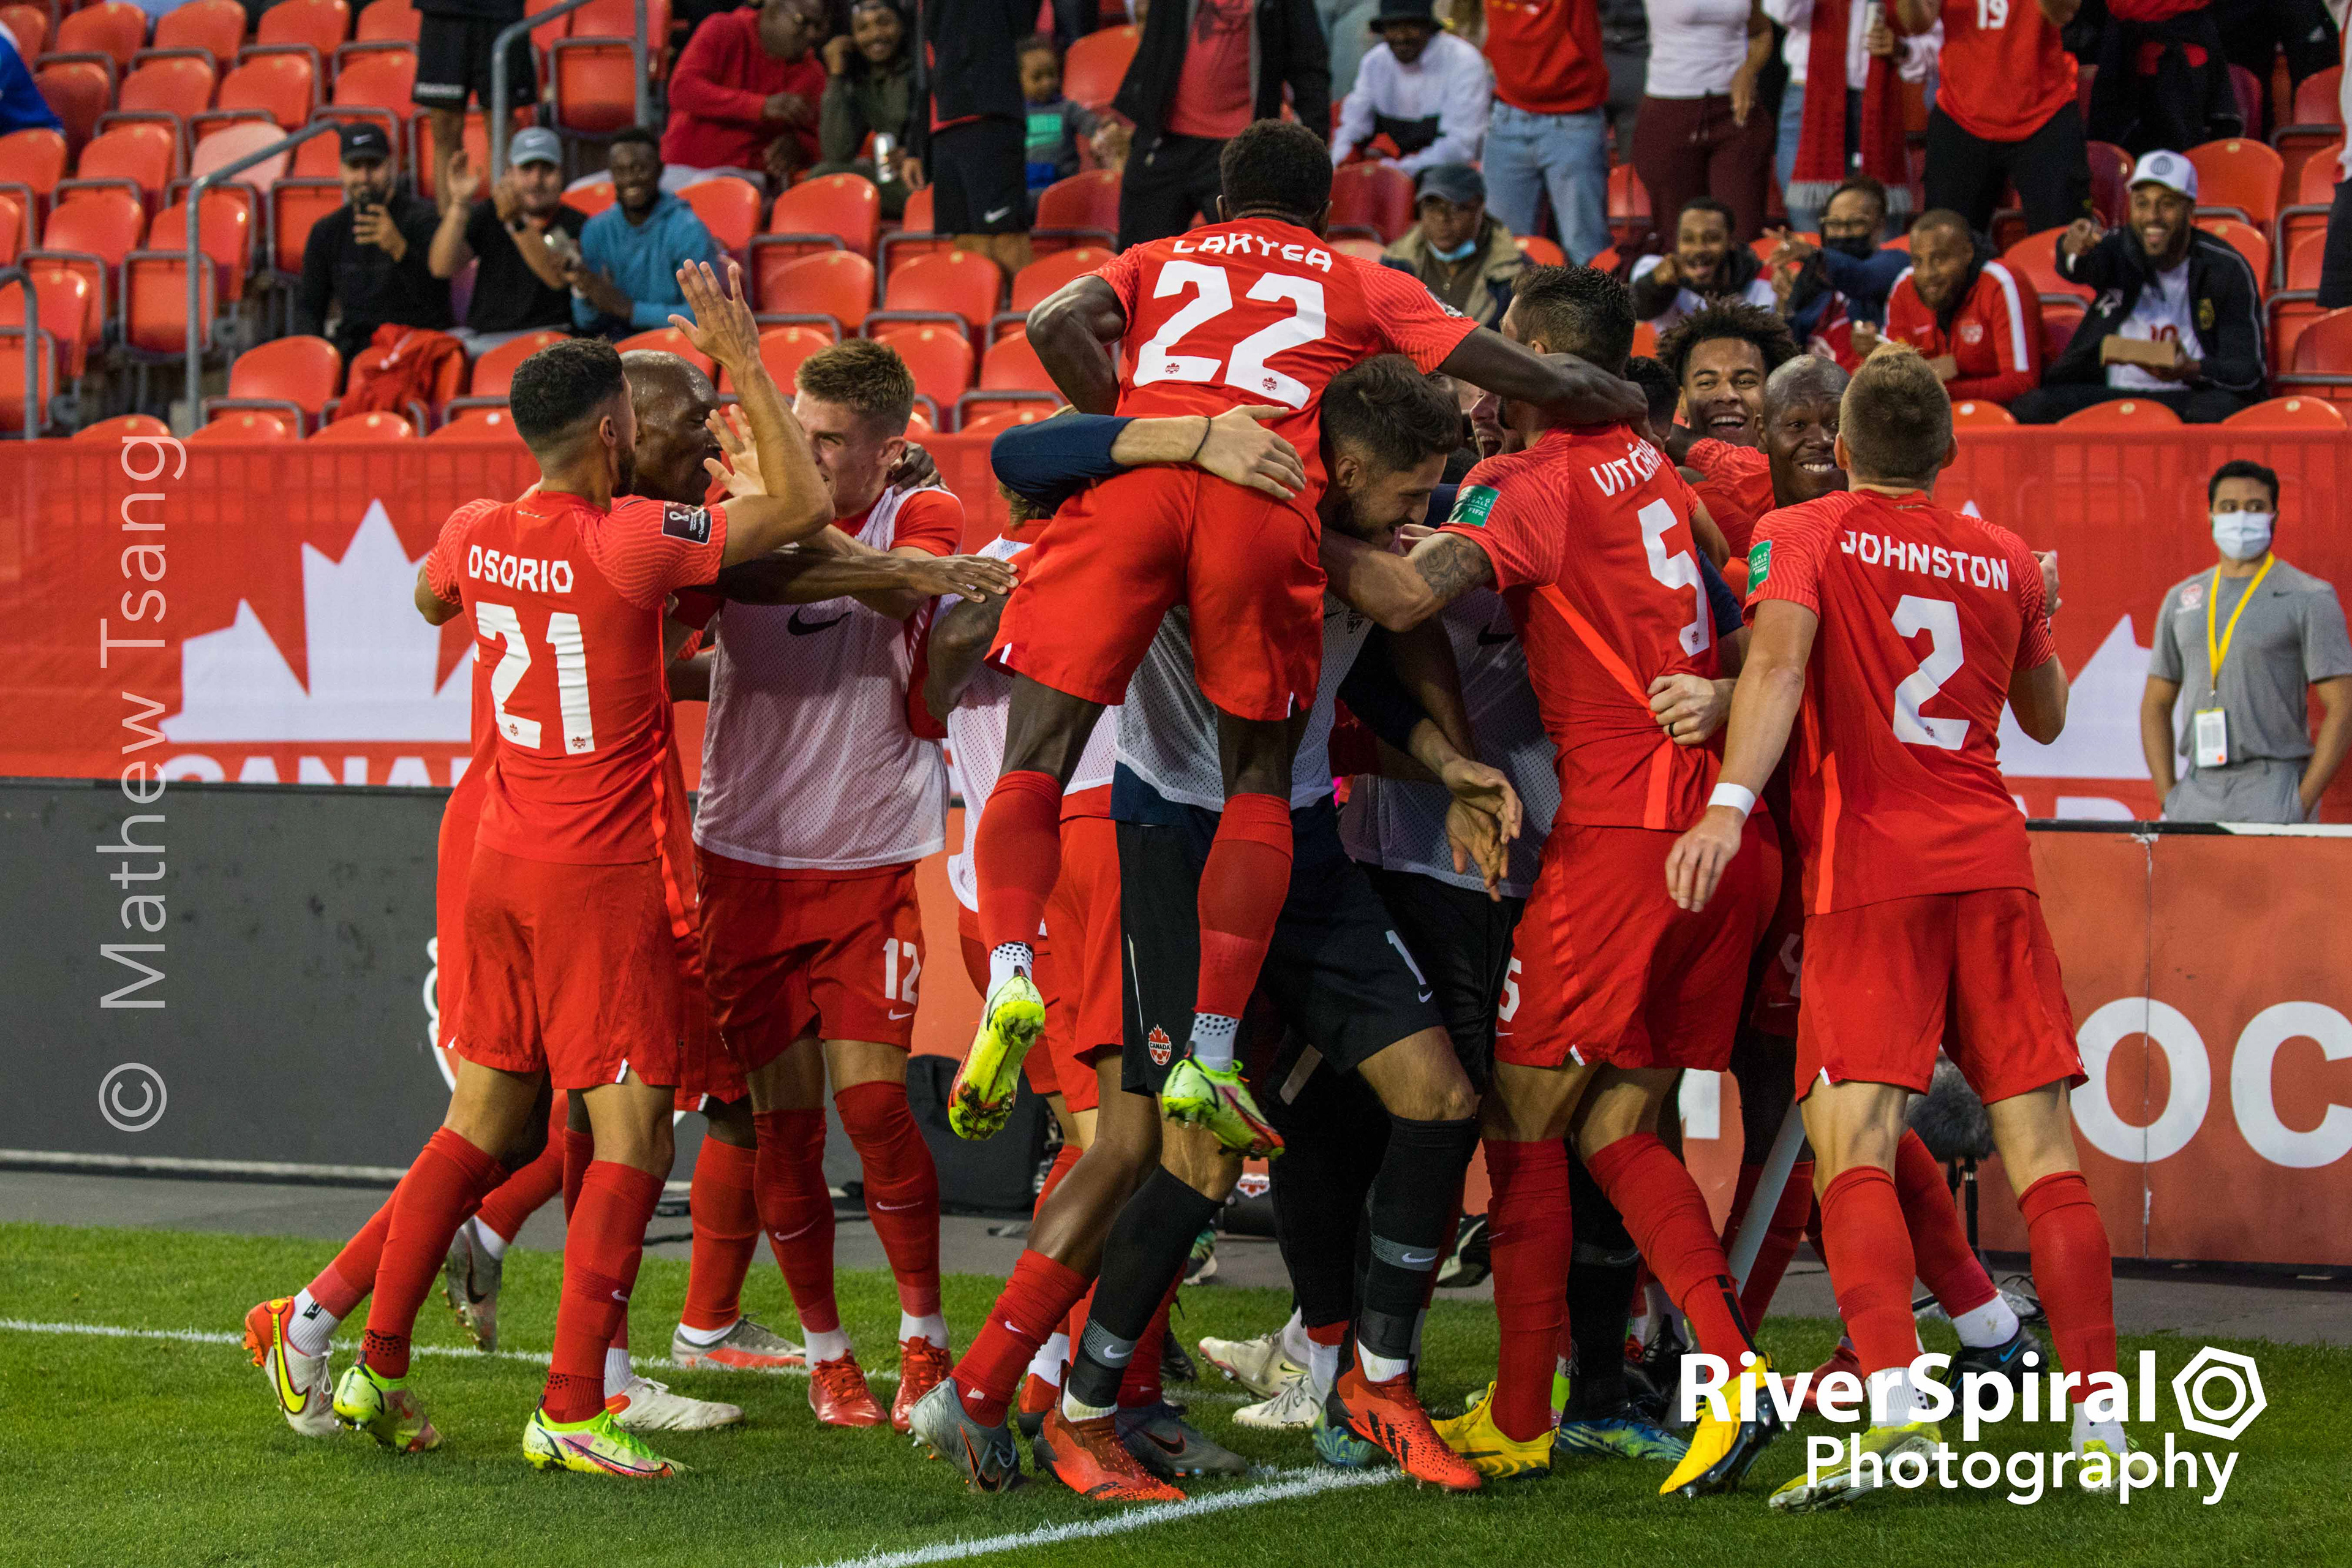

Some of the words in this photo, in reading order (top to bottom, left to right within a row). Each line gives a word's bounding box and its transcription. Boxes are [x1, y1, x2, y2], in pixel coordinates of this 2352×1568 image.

[1977, 0, 2008, 29] 19
[1173, 233, 1333, 273] LARYEA
[1133, 260, 1327, 410] 22
[1468, 507, 1485, 517] FIFA
[468, 545, 575, 593] OSORIO
[1638, 498, 1710, 657] 5
[1841, 530, 2009, 592] JOHNSTON
[475, 601, 595, 755] 21
[1891, 594, 1970, 750] 2
[883, 938, 921, 1006] 12
[1498, 956, 1521, 1022] 5
